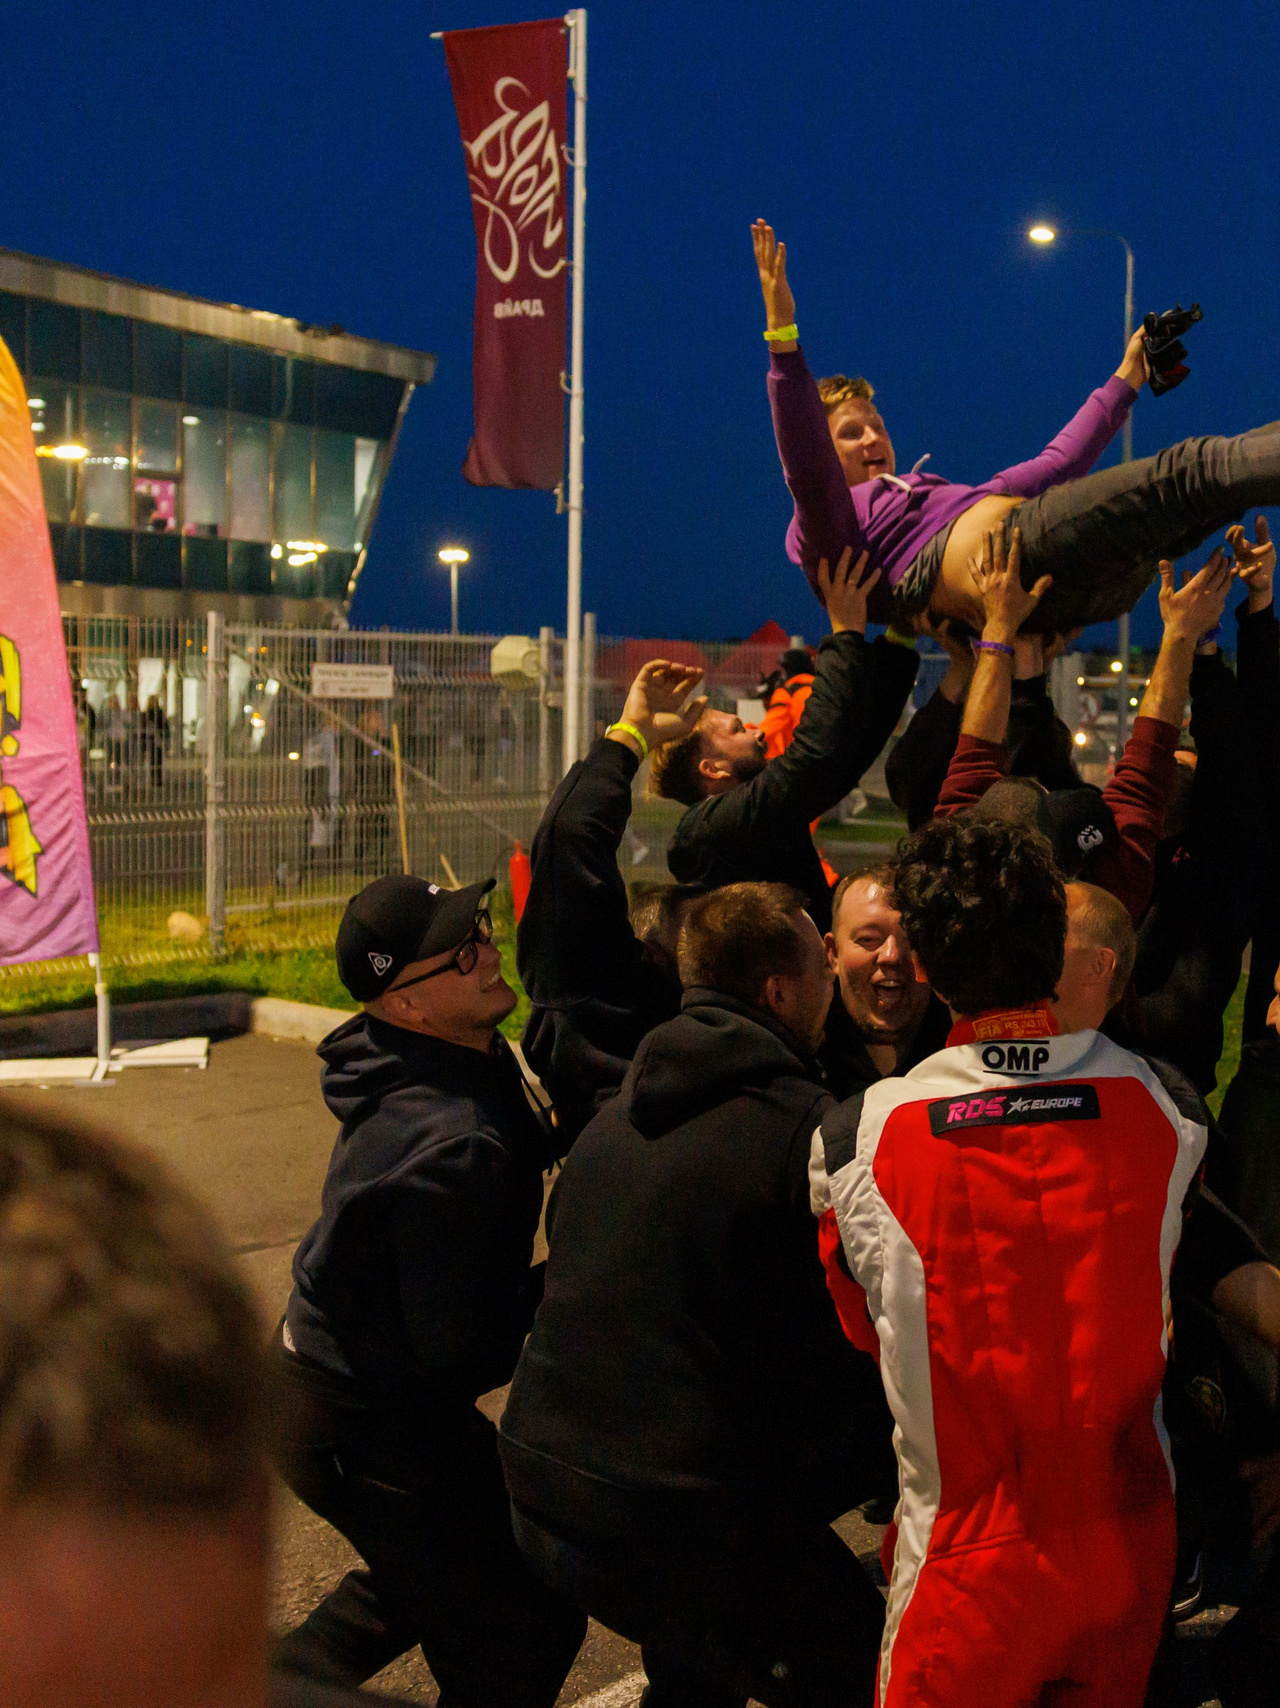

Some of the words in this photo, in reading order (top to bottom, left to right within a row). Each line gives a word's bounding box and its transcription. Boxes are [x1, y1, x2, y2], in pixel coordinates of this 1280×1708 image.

[981, 1045, 1050, 1071] OMP
[946, 1096, 1007, 1123] RDS
[1030, 1097, 1083, 1110] EUROPE
